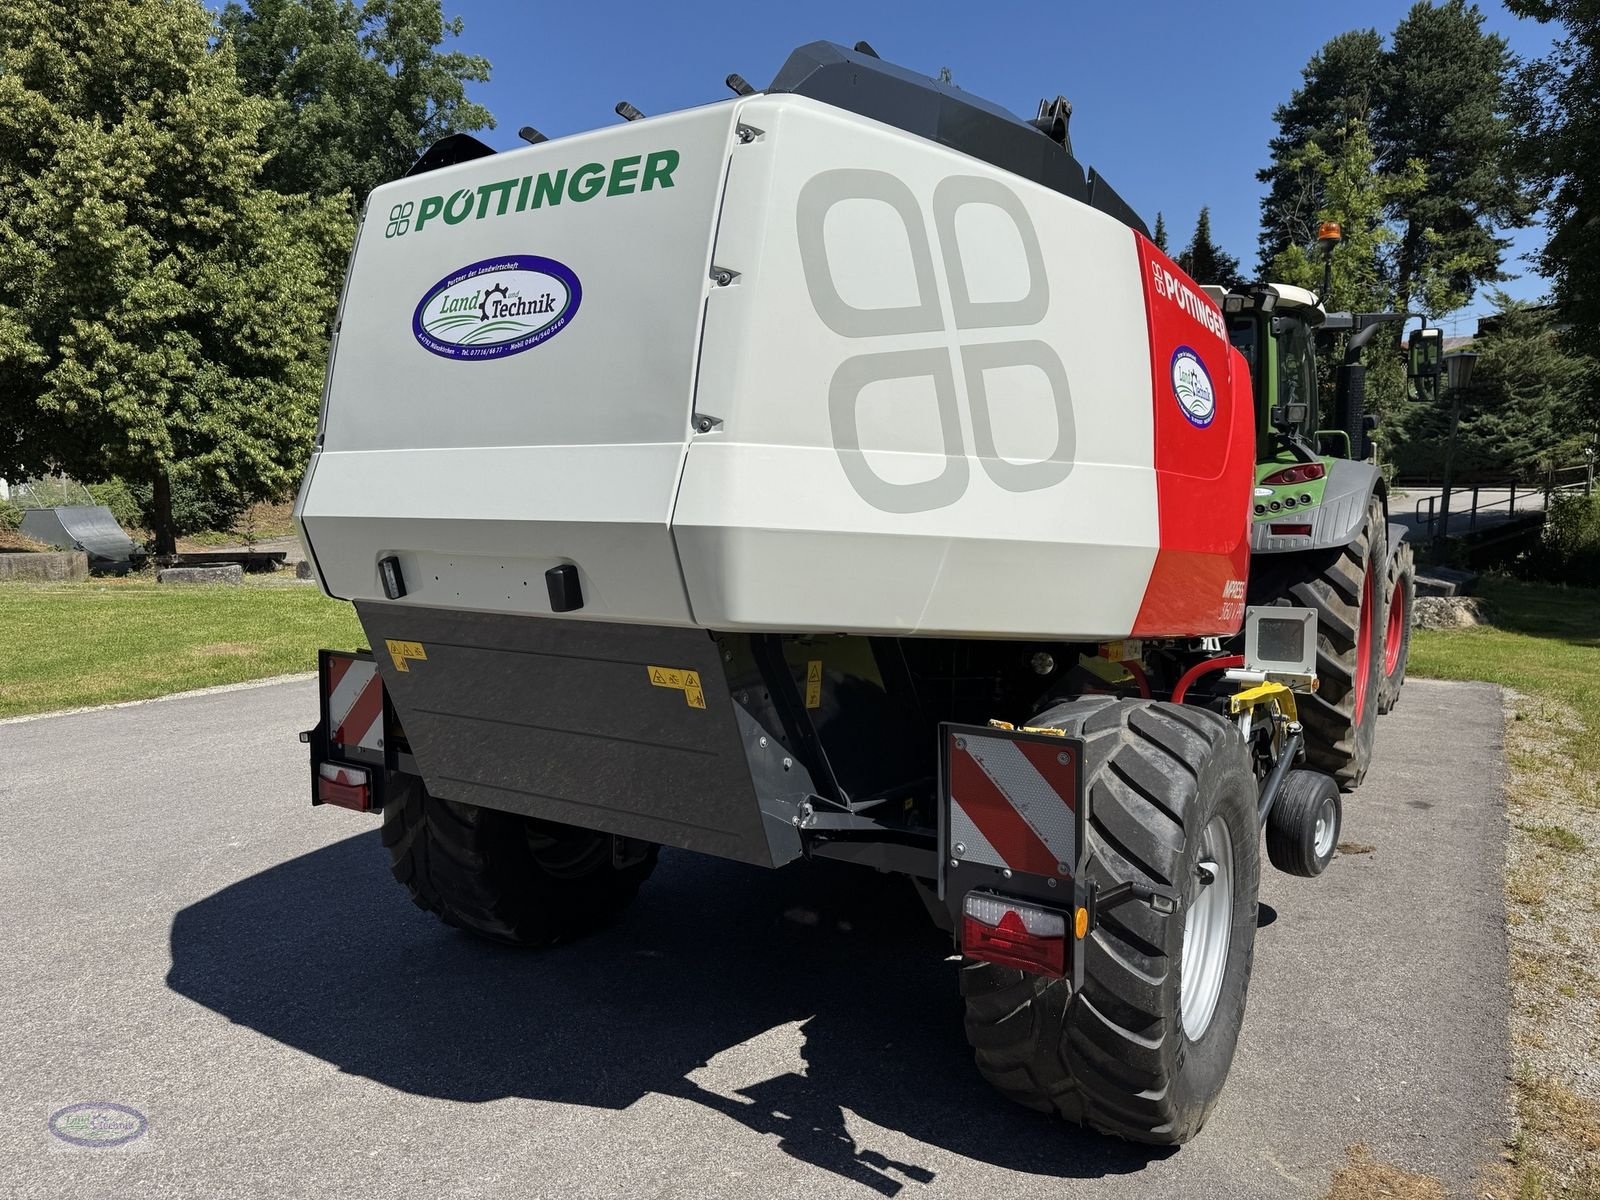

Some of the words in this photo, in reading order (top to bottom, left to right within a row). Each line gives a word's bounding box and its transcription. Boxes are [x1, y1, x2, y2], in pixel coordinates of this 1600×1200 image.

[414, 149, 680, 232] PÖTTINGER
[447, 274, 467, 287] Partner
[468, 270, 478, 278] der
[478, 262, 519, 275] Landwirtschaft
[440, 290, 481, 314] Land
[492, 293, 556, 318] Technik
[510, 341, 524, 350] Mobil
